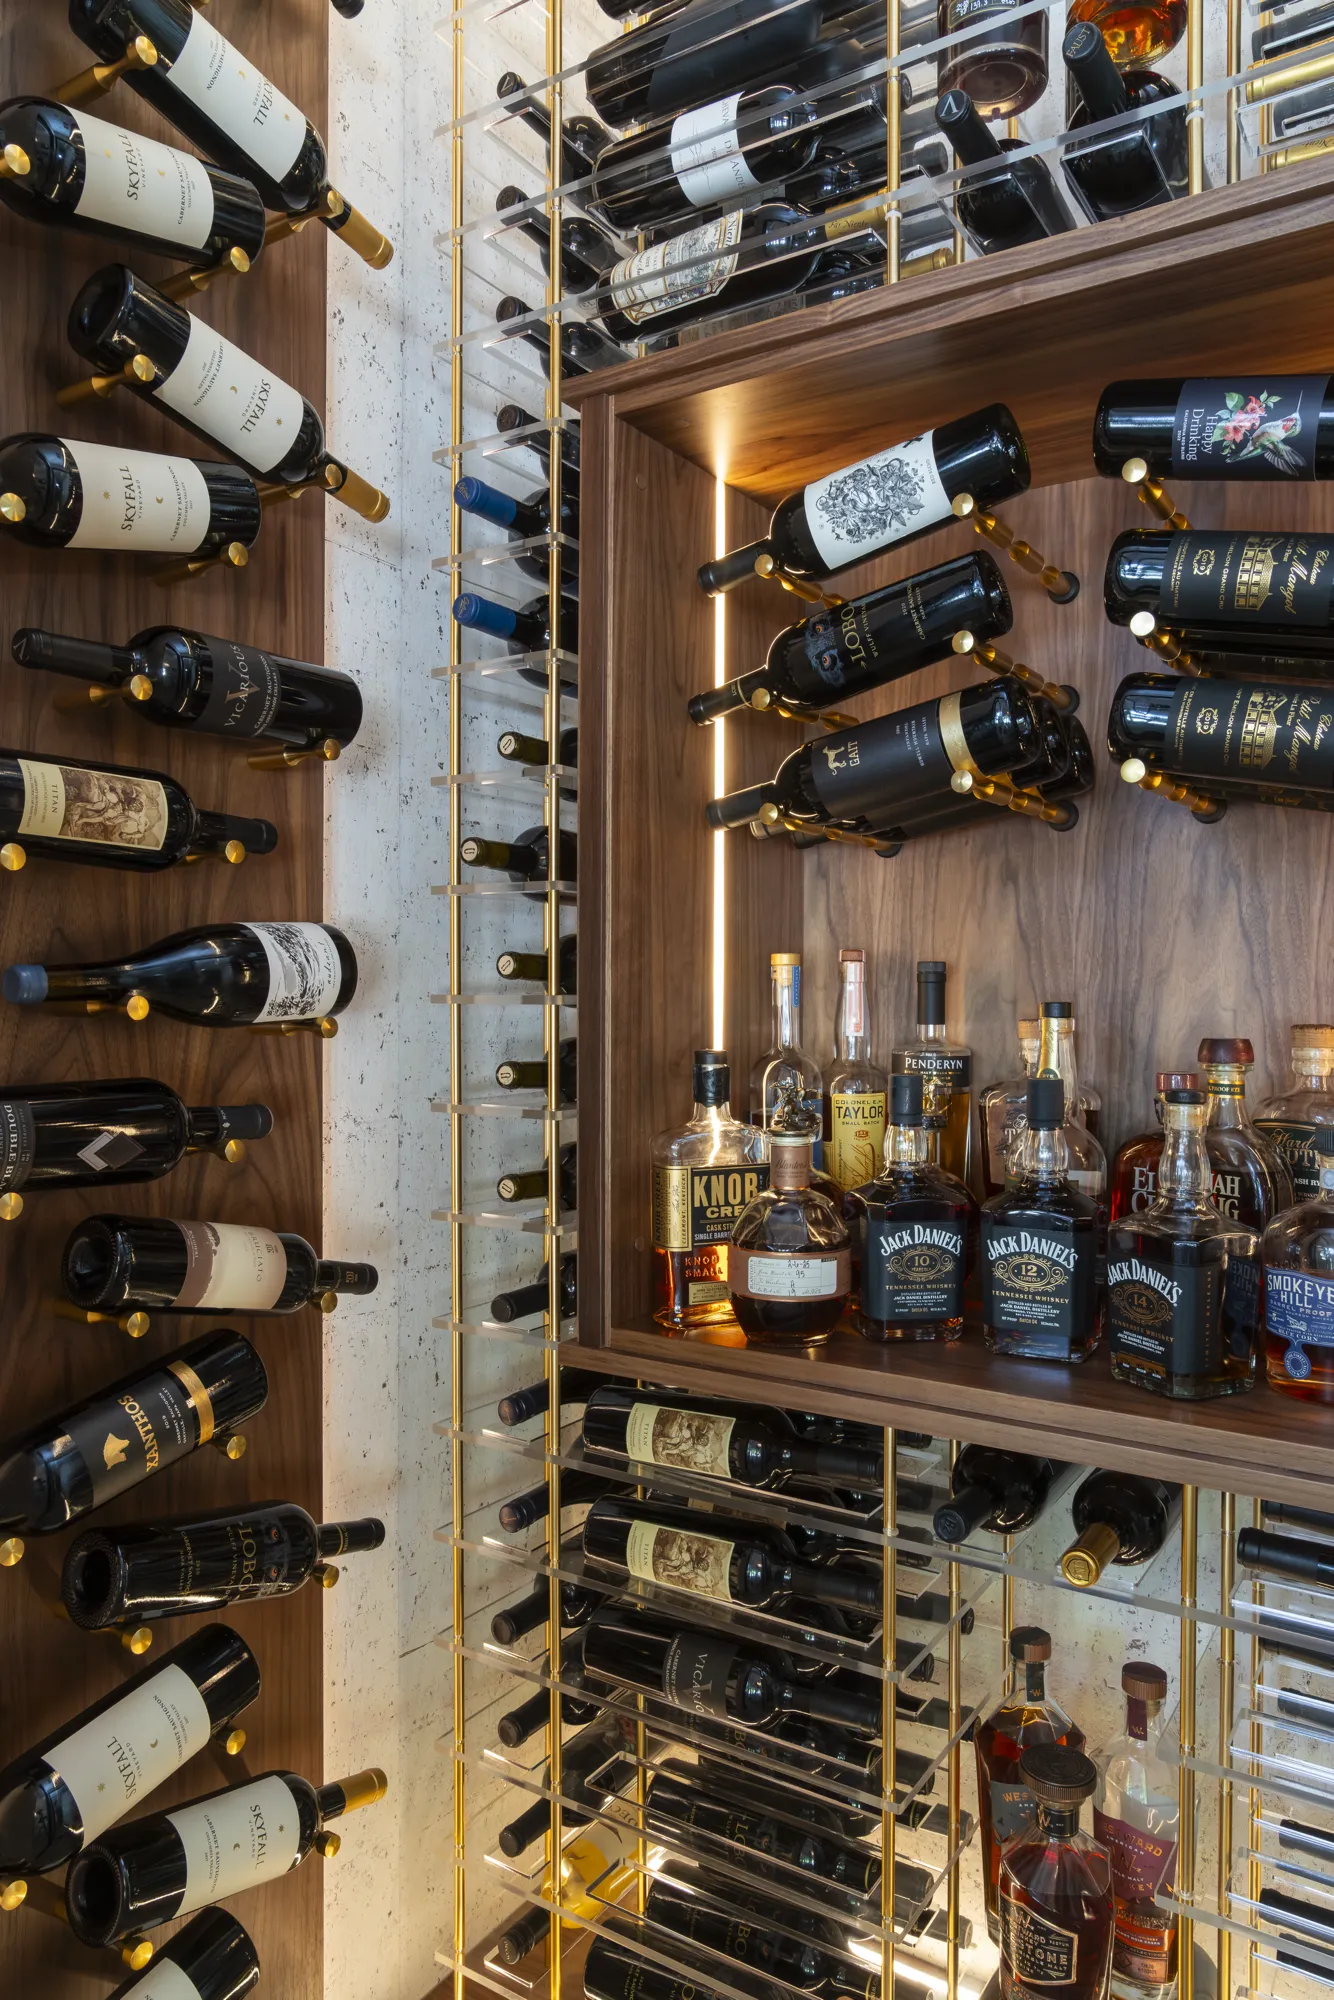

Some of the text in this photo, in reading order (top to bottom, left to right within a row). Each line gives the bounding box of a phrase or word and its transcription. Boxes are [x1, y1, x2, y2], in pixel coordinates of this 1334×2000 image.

[1066, 27, 1091, 58] FAUST
[117, 133, 140, 200] SKYFALL
[177, 184, 186, 225] CABERNET
[193, 372, 218, 407] SAUVIGNON
[240, 378, 271, 433] SKYFALL
[1186, 408, 1205, 461] Drinking
[1201, 416, 1219, 454] Happy
[119, 465, 137, 531] SKYFALL
[170, 507, 182, 541] CABERNET
[1199, 553, 1209, 571] 2019
[1220, 568, 1229, 593] GRAND
[1279, 554, 1308, 614] Mangot
[841, 606, 866, 662] LOBO
[911, 609, 926, 640] CABERNET
[223, 644, 249, 727] VICARIOUS
[254, 654, 272, 729] CABERNET SAUVIGNON
[1202, 711, 1212, 730] 2019
[1223, 699, 1240, 753] EMILION GRAND
[847, 740, 860, 767] GAIT
[905, 1057, 963, 1070] PENDERYN
[835, 1106, 884, 1120] TAYLOR
[3, 1104, 18, 1162] DOUBLE
[1268, 1129, 1316, 1150] Hard
[693, 1172, 758, 1208] KNOB
[705, 1205, 745, 1219] CRE
[706, 1223, 722, 1232] CASK
[694, 1231, 713, 1241] SINGLE
[880, 1224, 963, 1256] JACK DANIEL'S
[987, 1232, 1078, 1269] JACK DANIEL'S
[914, 1255, 930, 1267] 10
[1021, 1264, 1038, 1276] 12
[1107, 1258, 1182, 1304] JACK DANIEL'S
[1267, 1274, 1334, 1305] SMOKEYE
[992, 1290, 1070, 1304] TENNESSEE WHISKEY
[1132, 1294, 1148, 1308] 14
[1269, 1298, 1297, 1312] BARREL
[1299, 1307, 1332, 1317] PROOF
[1280, 1290, 1312, 1309] HILL
[1111, 1318, 1175, 1343] TENNESSEE WHISKEY
[1277, 1328, 1319, 1342] BLUE CORN
[161, 1386, 176, 1404] VALLEY
[173, 1403, 182, 1418] NAPA
[117, 1395, 159, 1472] XANTHOS
[161, 1414, 170, 1430] 2019
[173, 1419, 183, 1445] CABERNET
[238, 1526, 257, 1592] LOBO
[670, 1649, 681, 1685] CABERNET
[152, 1694, 178, 1731] SAUVIGNON
[107, 1736, 137, 1800] SKYFALL
[203, 1814, 219, 1850] CABERNET
[249, 1804, 267, 1870] SKYFALL
[1106, 1835, 1145, 1855] AMERICAN
[1047, 1963, 1067, 1971] MALT
